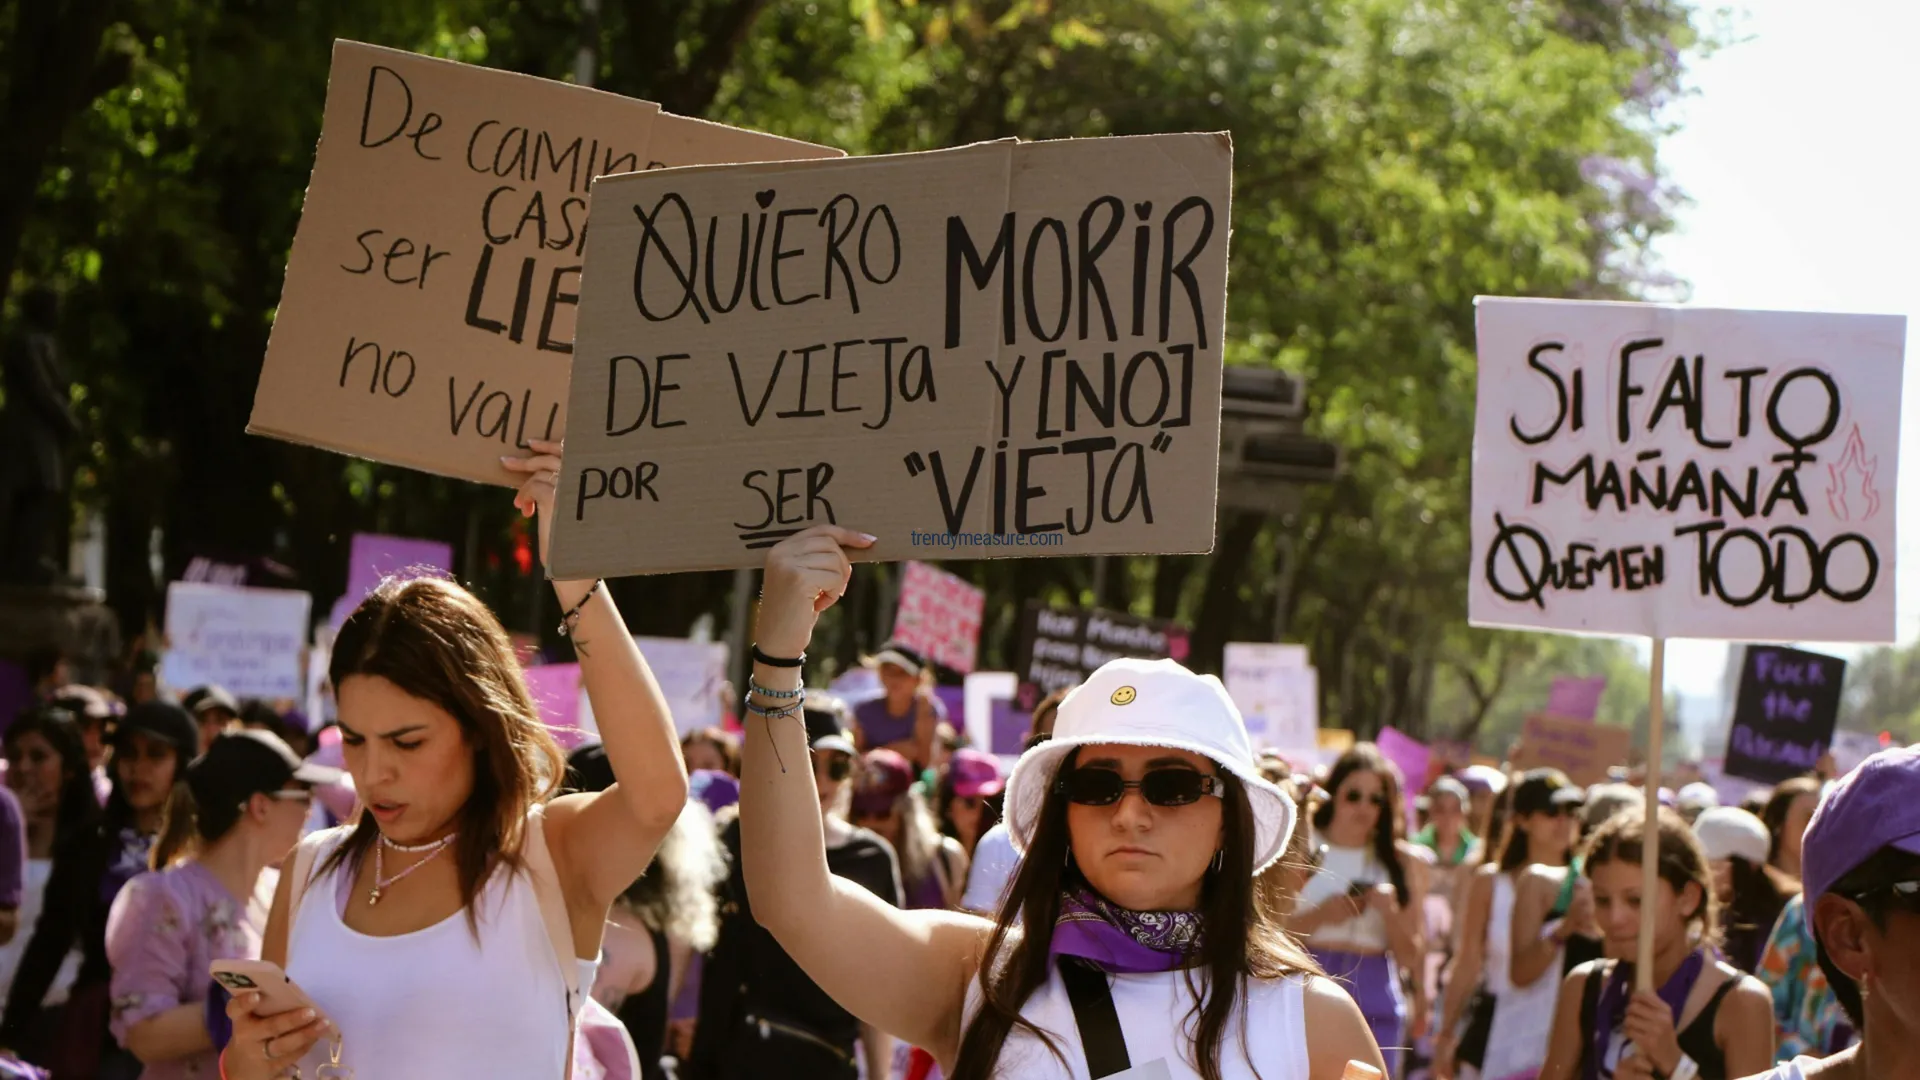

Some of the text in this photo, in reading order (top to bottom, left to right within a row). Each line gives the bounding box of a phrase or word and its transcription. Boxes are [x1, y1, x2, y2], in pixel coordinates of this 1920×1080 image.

[361, 65, 442, 161] De
[340, 229, 451, 289] ser
[339, 336, 416, 398] no
[606, 353, 691, 437] DE
[1510, 337, 1841, 460] SI FALTO
[734, 461, 837, 530] SER
[1531, 449, 1809, 519] MAÑANA
[1674, 520, 1880, 608] TODO
